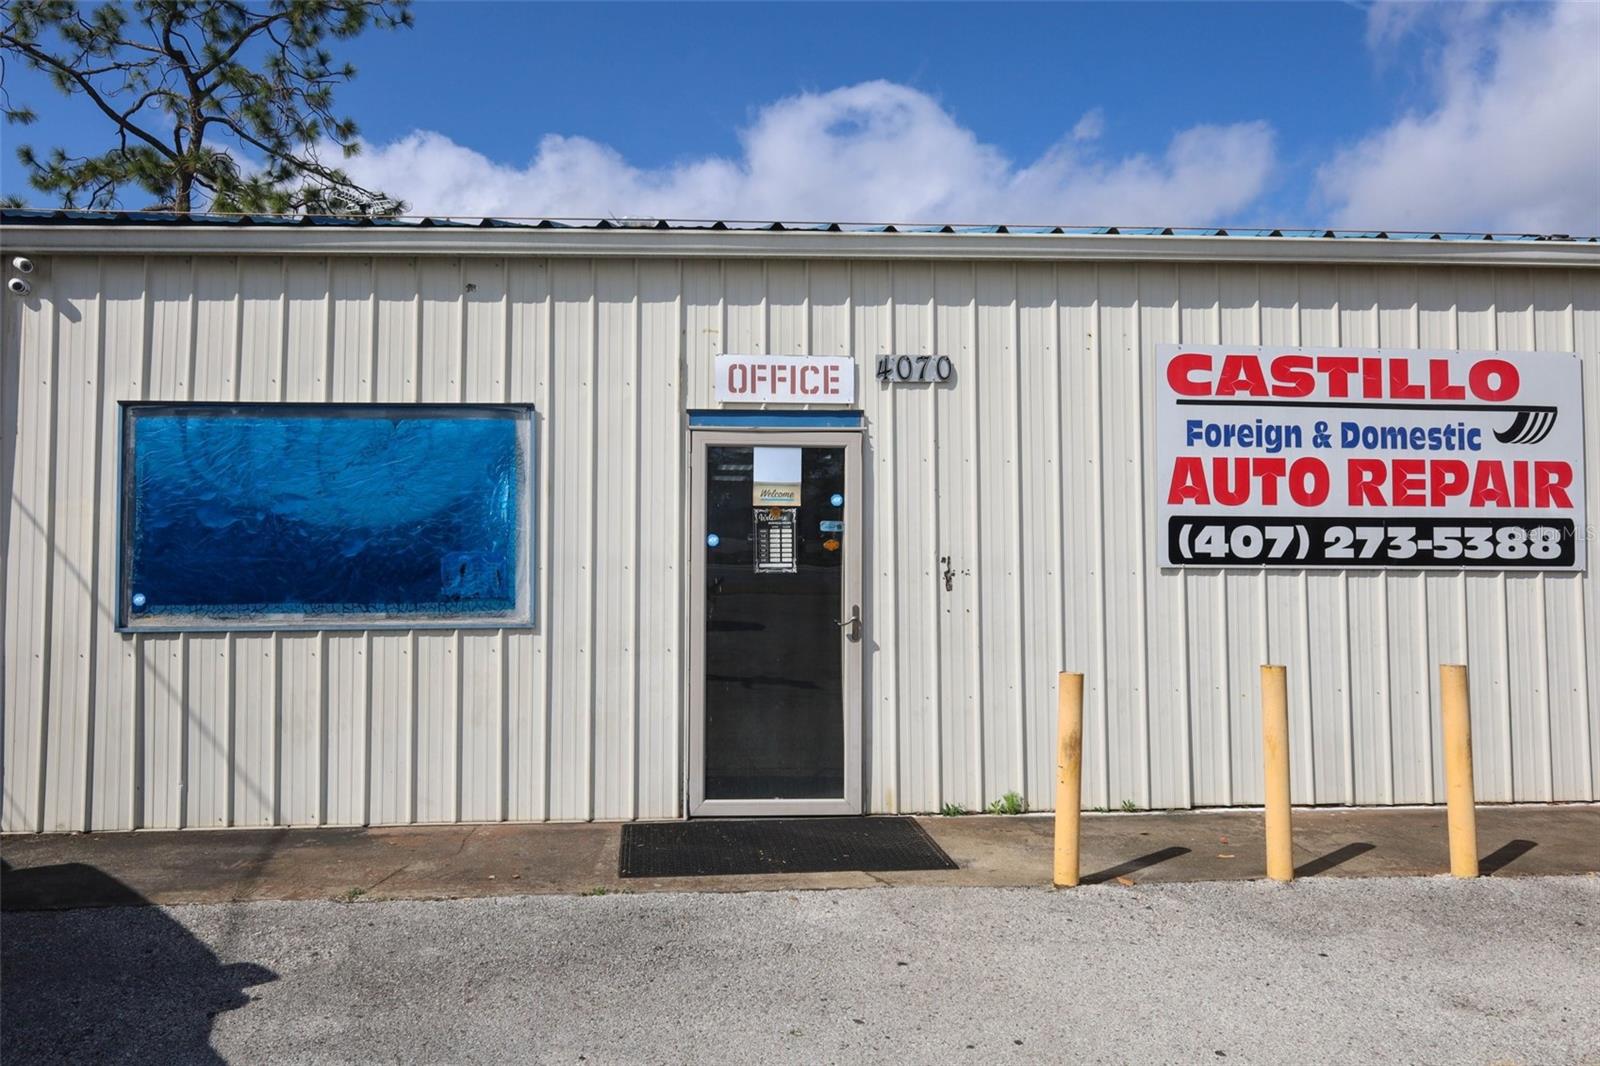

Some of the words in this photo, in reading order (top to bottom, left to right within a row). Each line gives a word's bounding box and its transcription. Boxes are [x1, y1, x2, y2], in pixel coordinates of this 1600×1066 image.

[728, 363, 840, 395] OFFICE
[876, 355, 952, 380] 4070
[1166, 352, 1520, 402] CASTILLO
[1186, 419, 1301, 454] Foreign
[1312, 421, 1333, 449] &
[1340, 421, 1482, 452] Domestic
[760, 488, 795, 498] Welcome
[1167, 457, 1330, 507] AUTO
[1347, 459, 1574, 509] REPAIR
[1178, 524, 1311, 561] (407)
[1324, 526, 1562, 561] 273-5388
